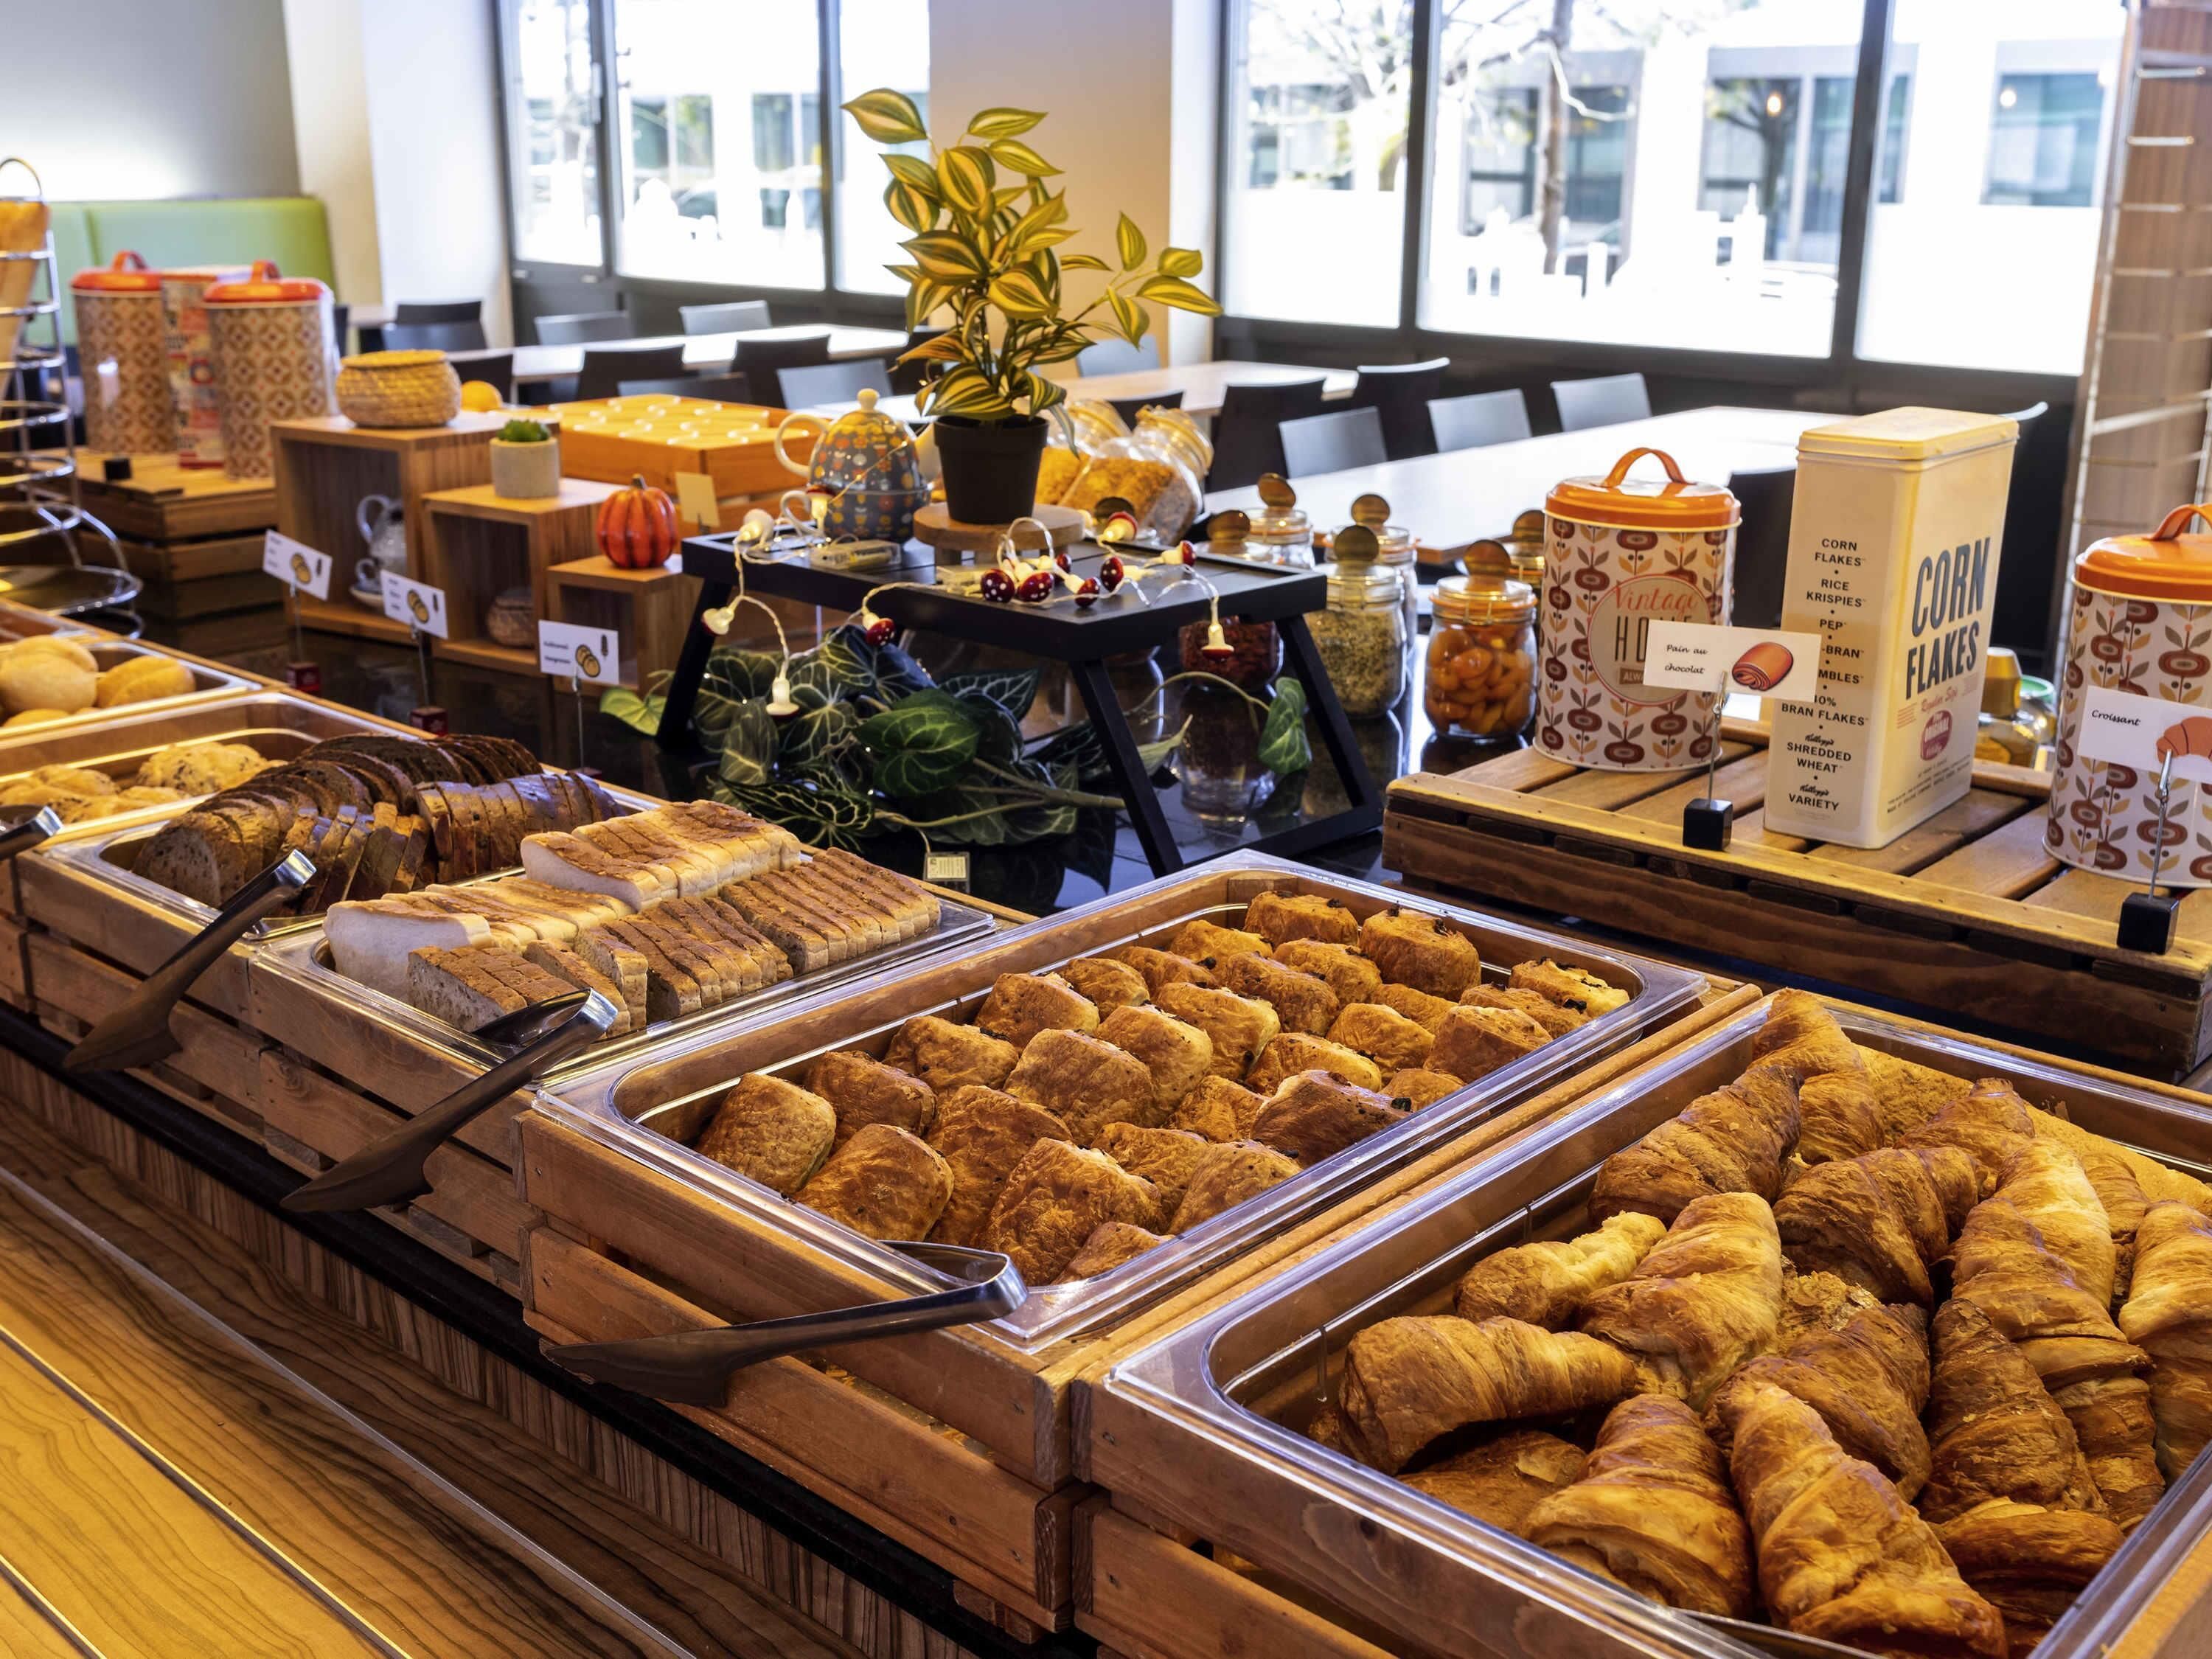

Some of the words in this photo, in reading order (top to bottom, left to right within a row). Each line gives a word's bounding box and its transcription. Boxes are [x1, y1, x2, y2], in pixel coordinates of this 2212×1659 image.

[1822, 538, 1857, 551] CORN
[1815, 552, 1862, 566] FLAKES
[1821, 578, 1850, 591] RICE
[1912, 537, 1991, 638] CORN
[1615, 582, 1697, 616] Vintage
[1806, 591, 1863, 608] KRISPIES
[1820, 619, 1843, 630] PEP
[1666, 644, 1691, 653] Pain
[1822, 645, 1860, 658] -BRAN
[1906, 620, 1980, 700] FLAKES
[1665, 663, 1705, 674] chocolat
[1818, 669, 1860, 684] MBLES
[1781, 703, 1814, 717] BRAN
[1818, 710, 1865, 726] FLAKES
[2091, 709, 2141, 726] Croissant
[1787, 742, 1851, 761] SHREDDED
[1797, 758, 1838, 773] WHEAT
[1789, 793, 1840, 811] VARIETY
